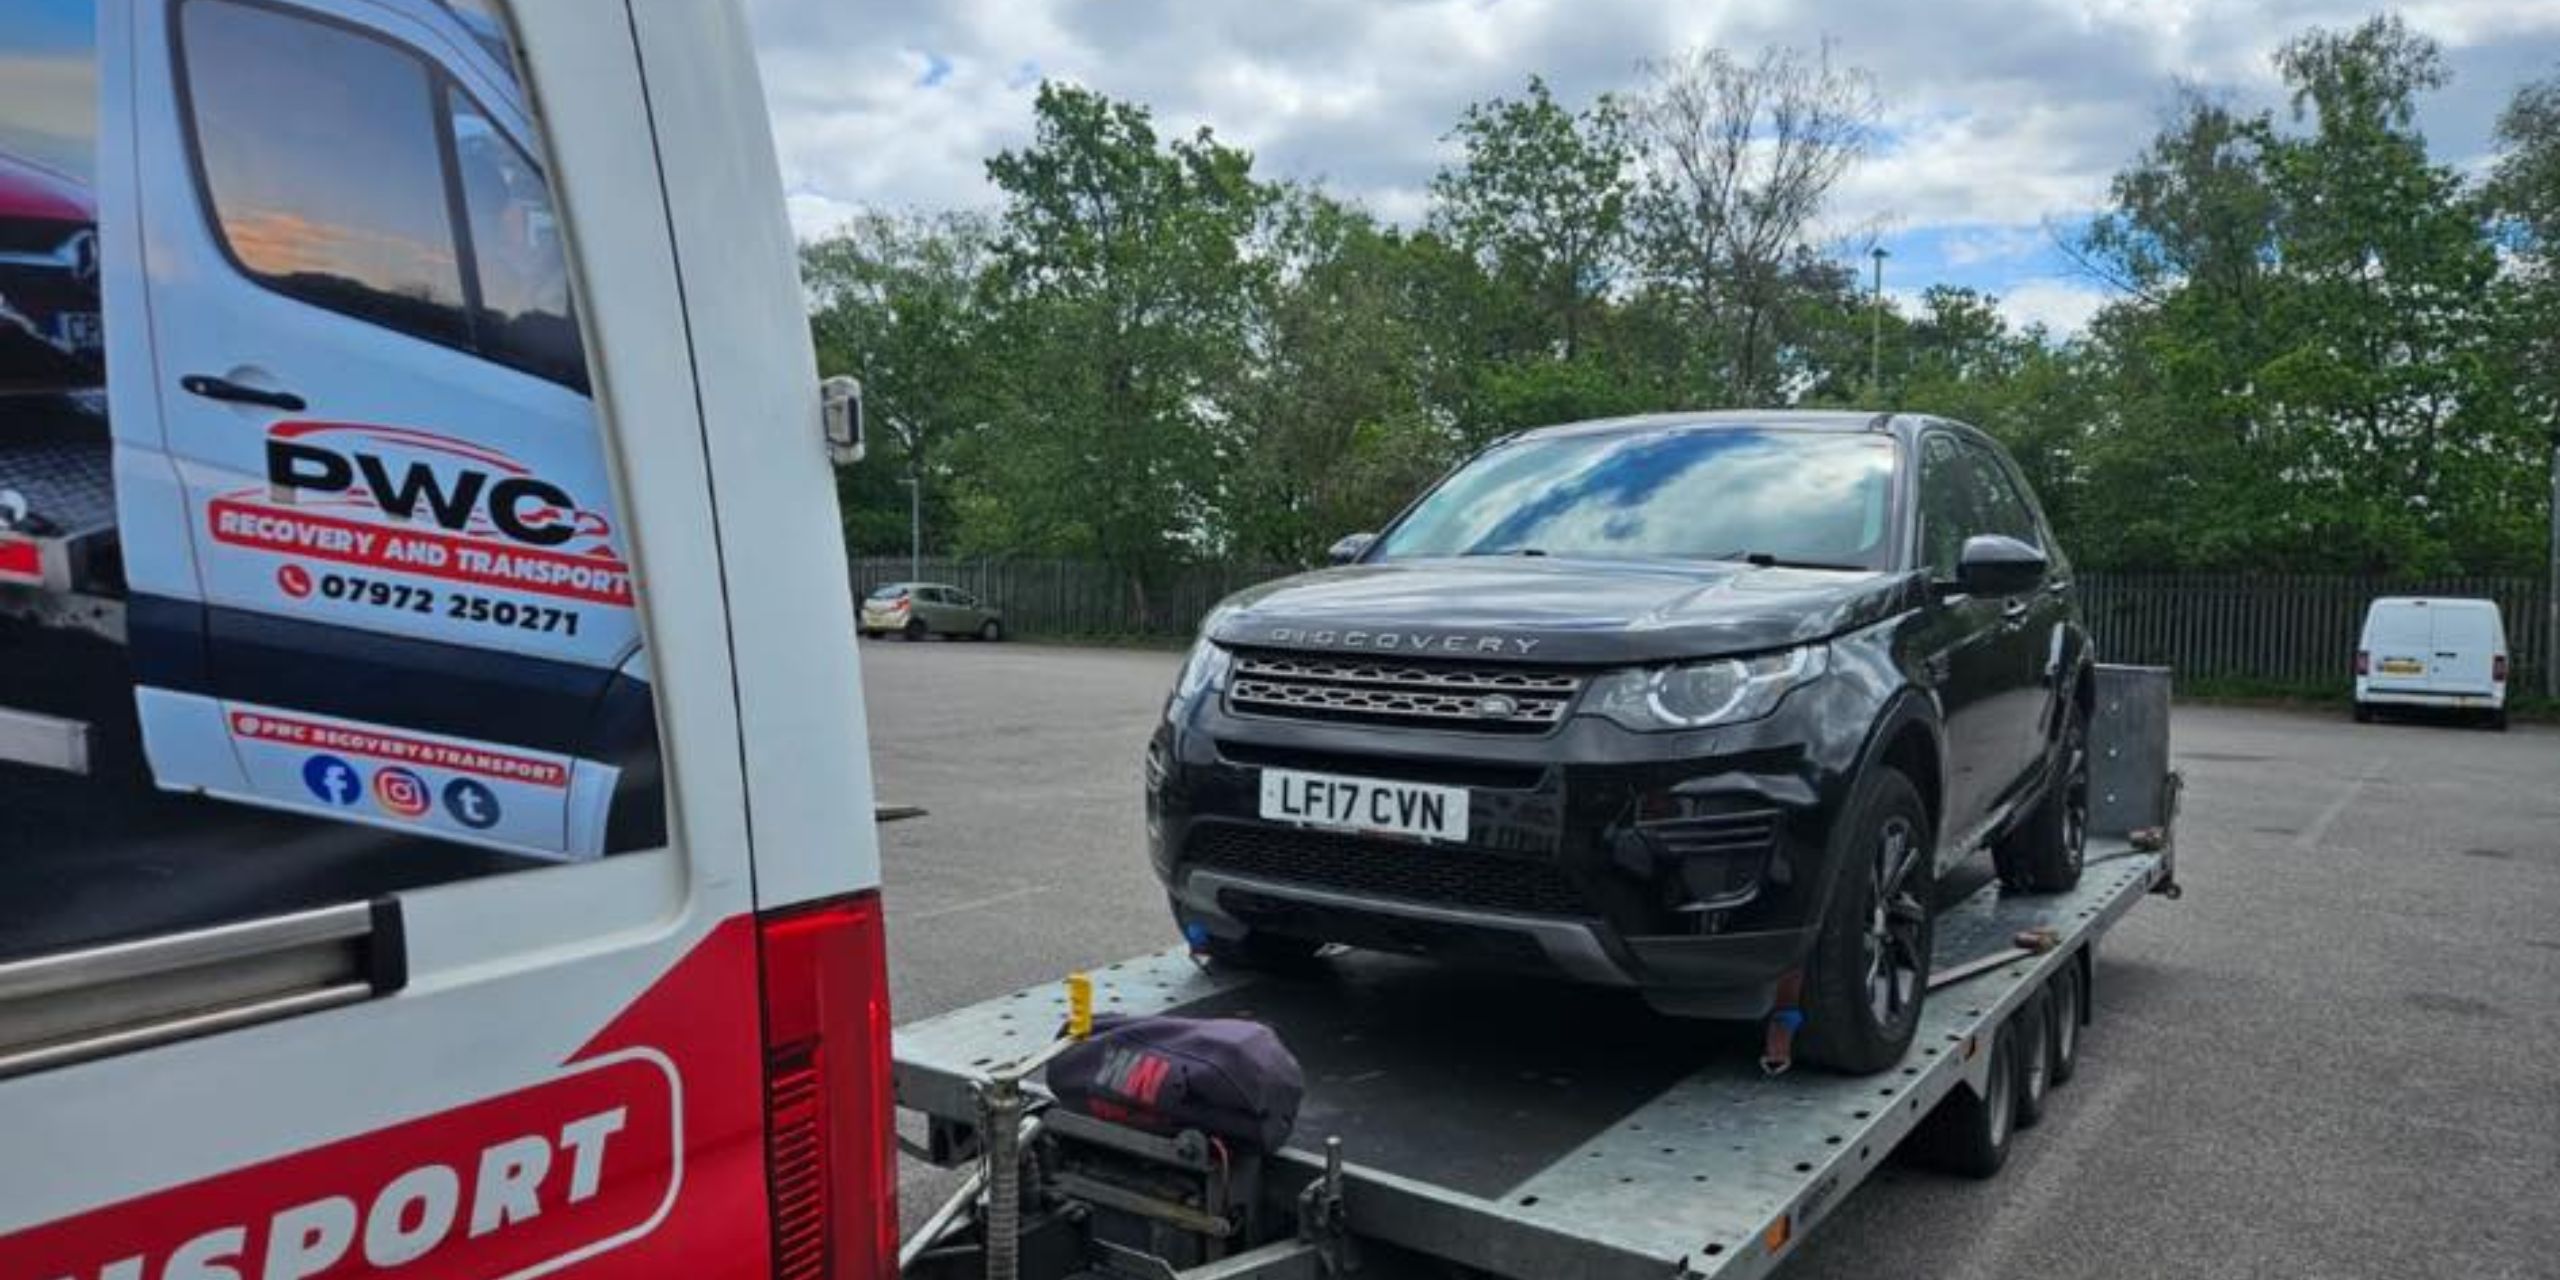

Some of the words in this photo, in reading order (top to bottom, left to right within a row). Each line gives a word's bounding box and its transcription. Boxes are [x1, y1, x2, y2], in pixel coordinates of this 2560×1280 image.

[266, 438, 577, 545] PWC
[218, 510, 376, 555] RECOVERY
[382, 537, 448, 567] AND
[454, 547, 630, 594] TRANSPORT
[321, 573, 433, 613] 07972
[448, 594, 579, 636] 250271
[1271, 628, 1540, 654] DISCOVERY
[1281, 777, 1359, 820] LF17
[1370, 788, 1445, 832] CVN
